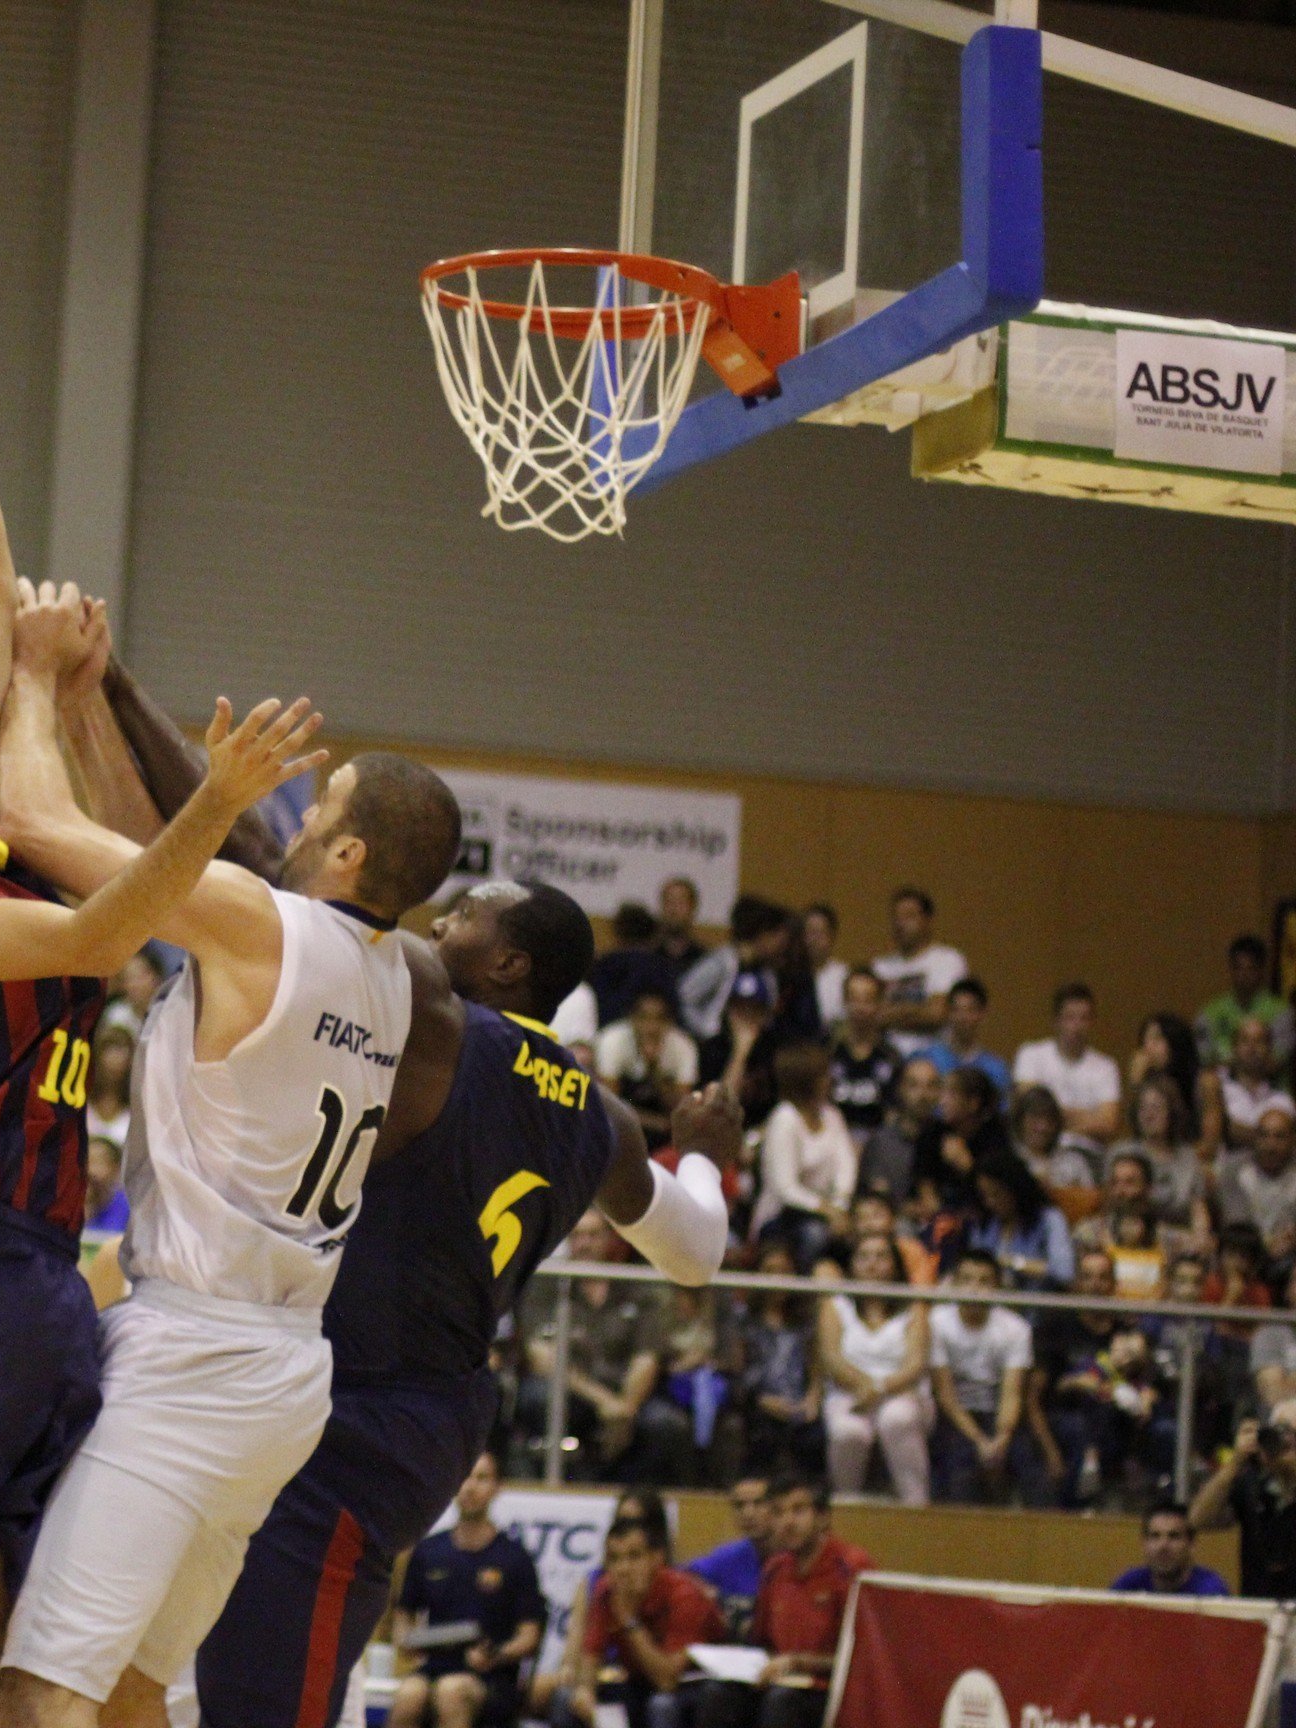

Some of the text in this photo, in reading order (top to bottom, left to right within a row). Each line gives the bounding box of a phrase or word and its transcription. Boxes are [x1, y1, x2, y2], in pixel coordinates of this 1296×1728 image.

[1126, 361, 1277, 413] ABSJV
[507, 803, 728, 860] Sponsorship
[37, 1027, 91, 1109] 10
